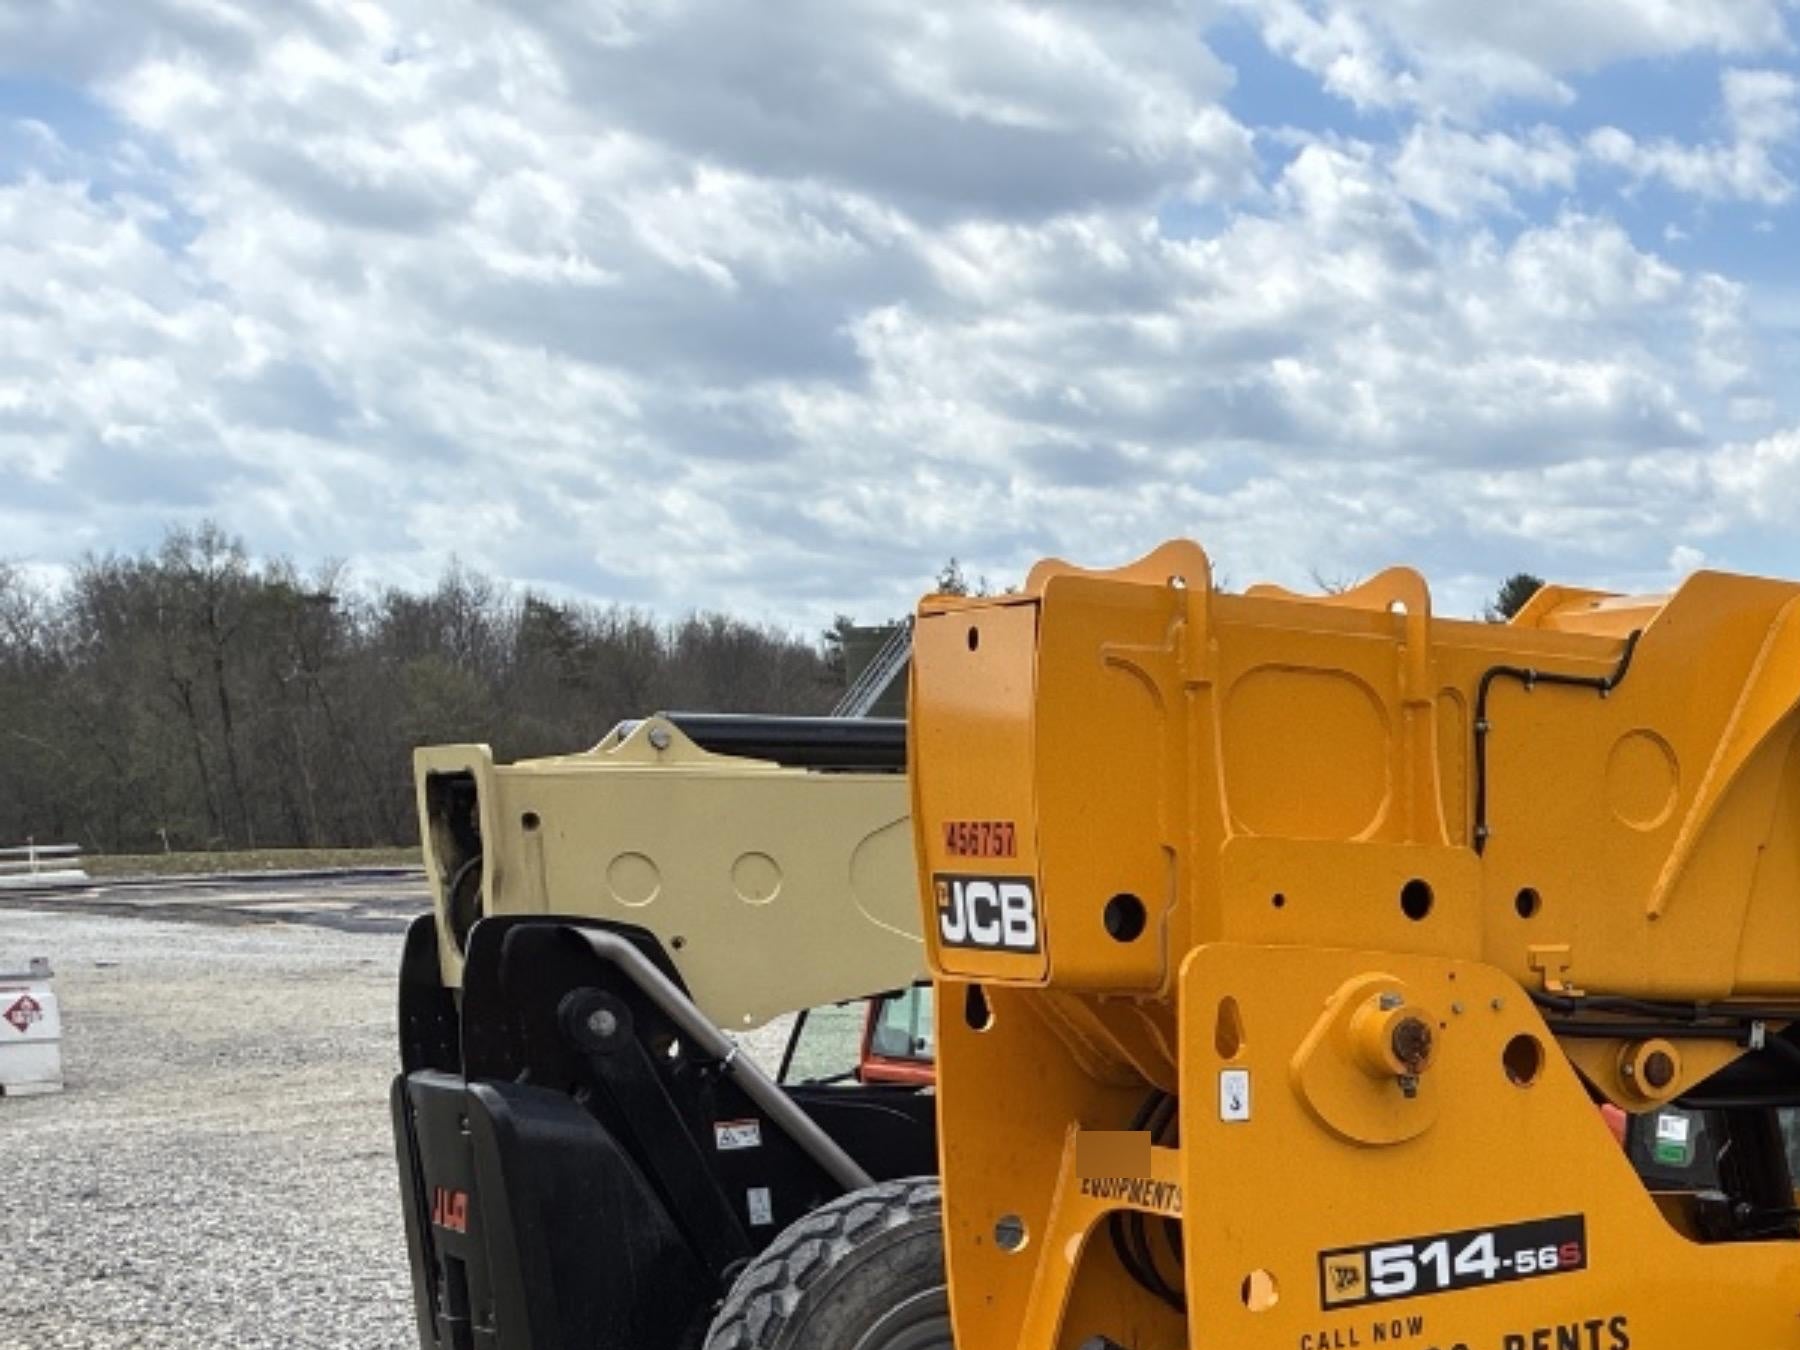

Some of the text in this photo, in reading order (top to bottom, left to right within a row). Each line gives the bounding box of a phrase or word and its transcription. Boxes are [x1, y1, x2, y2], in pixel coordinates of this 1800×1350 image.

[946, 821, 1015, 857] 456757
[940, 880, 1037, 947] JCB
[1372, 1315, 1423, 1343] NOW
